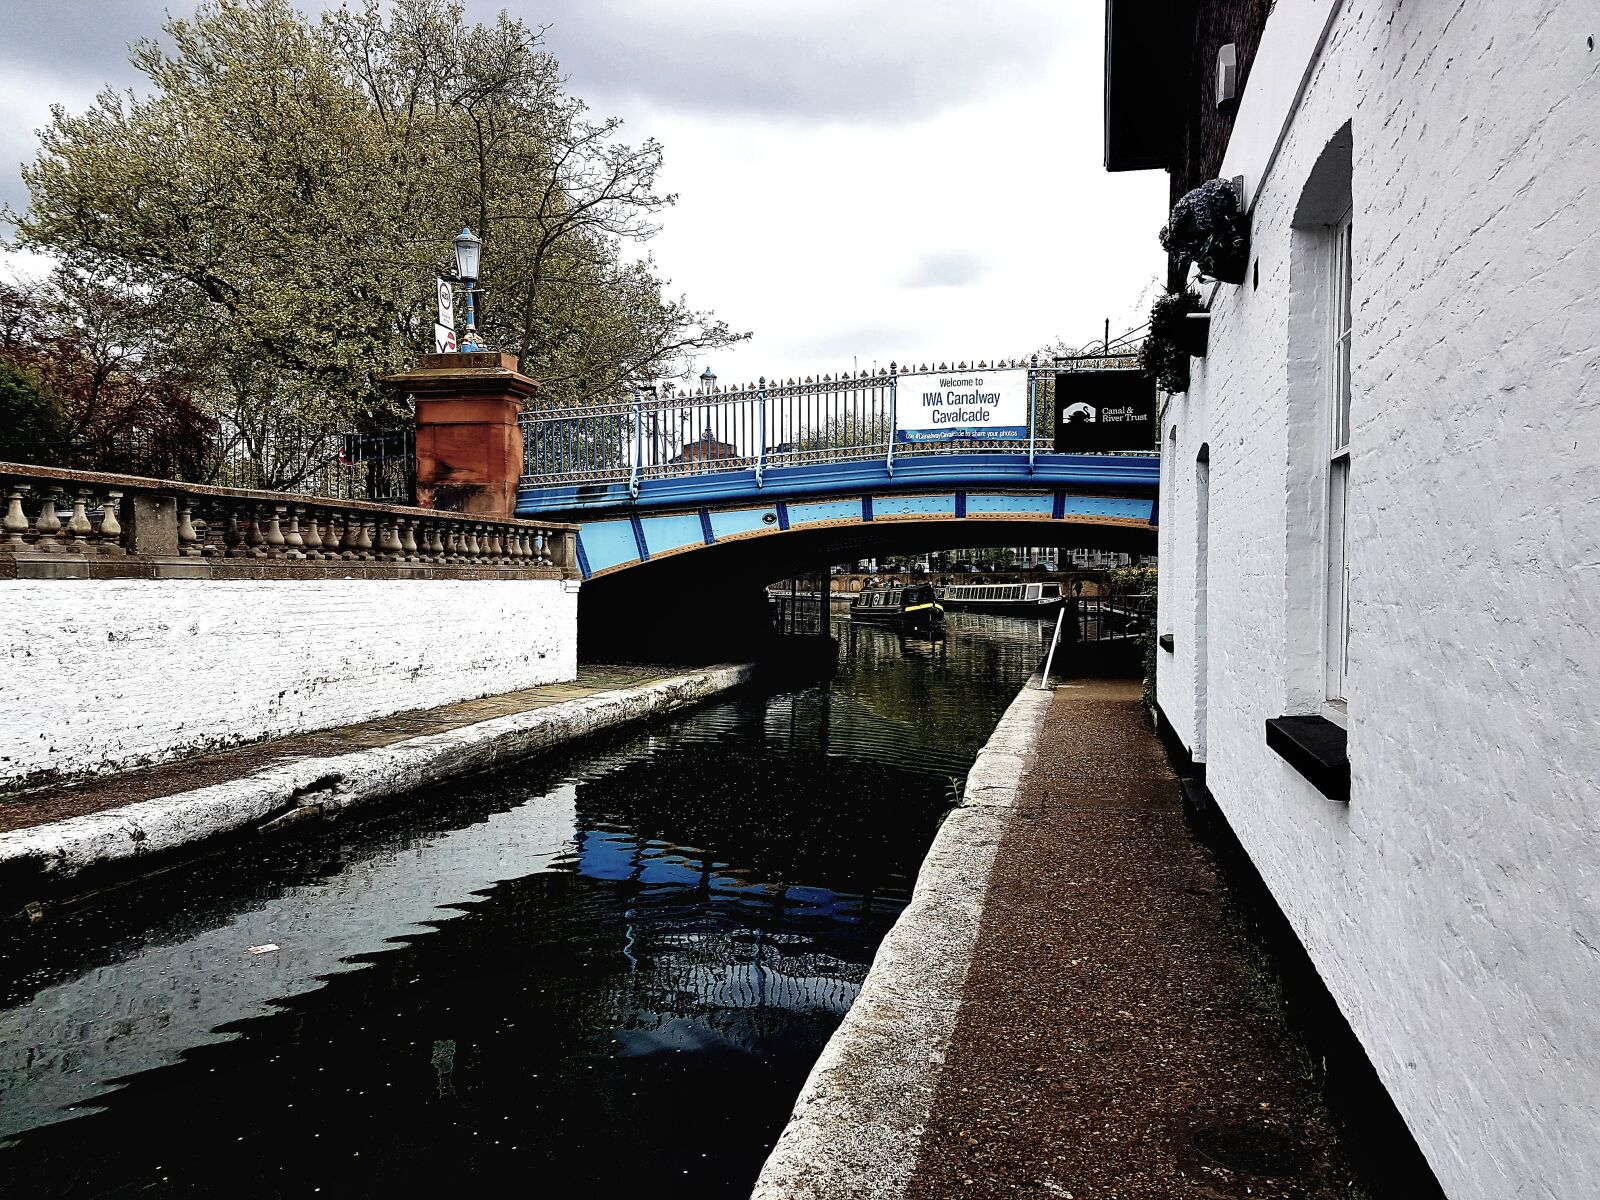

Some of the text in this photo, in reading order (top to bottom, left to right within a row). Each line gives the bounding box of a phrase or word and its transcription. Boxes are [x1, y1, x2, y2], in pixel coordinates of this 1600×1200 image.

[939, 377, 984, 388] Welcome to
[922, 389, 1001, 408] IWA Canalway
[932, 406, 990, 424] Cavalcade
[1101, 406, 1134, 414] Canal &
[1102, 413, 1147, 422] River Trust
[987, 430, 999, 439] your
[1000, 429, 1018, 438] photos
